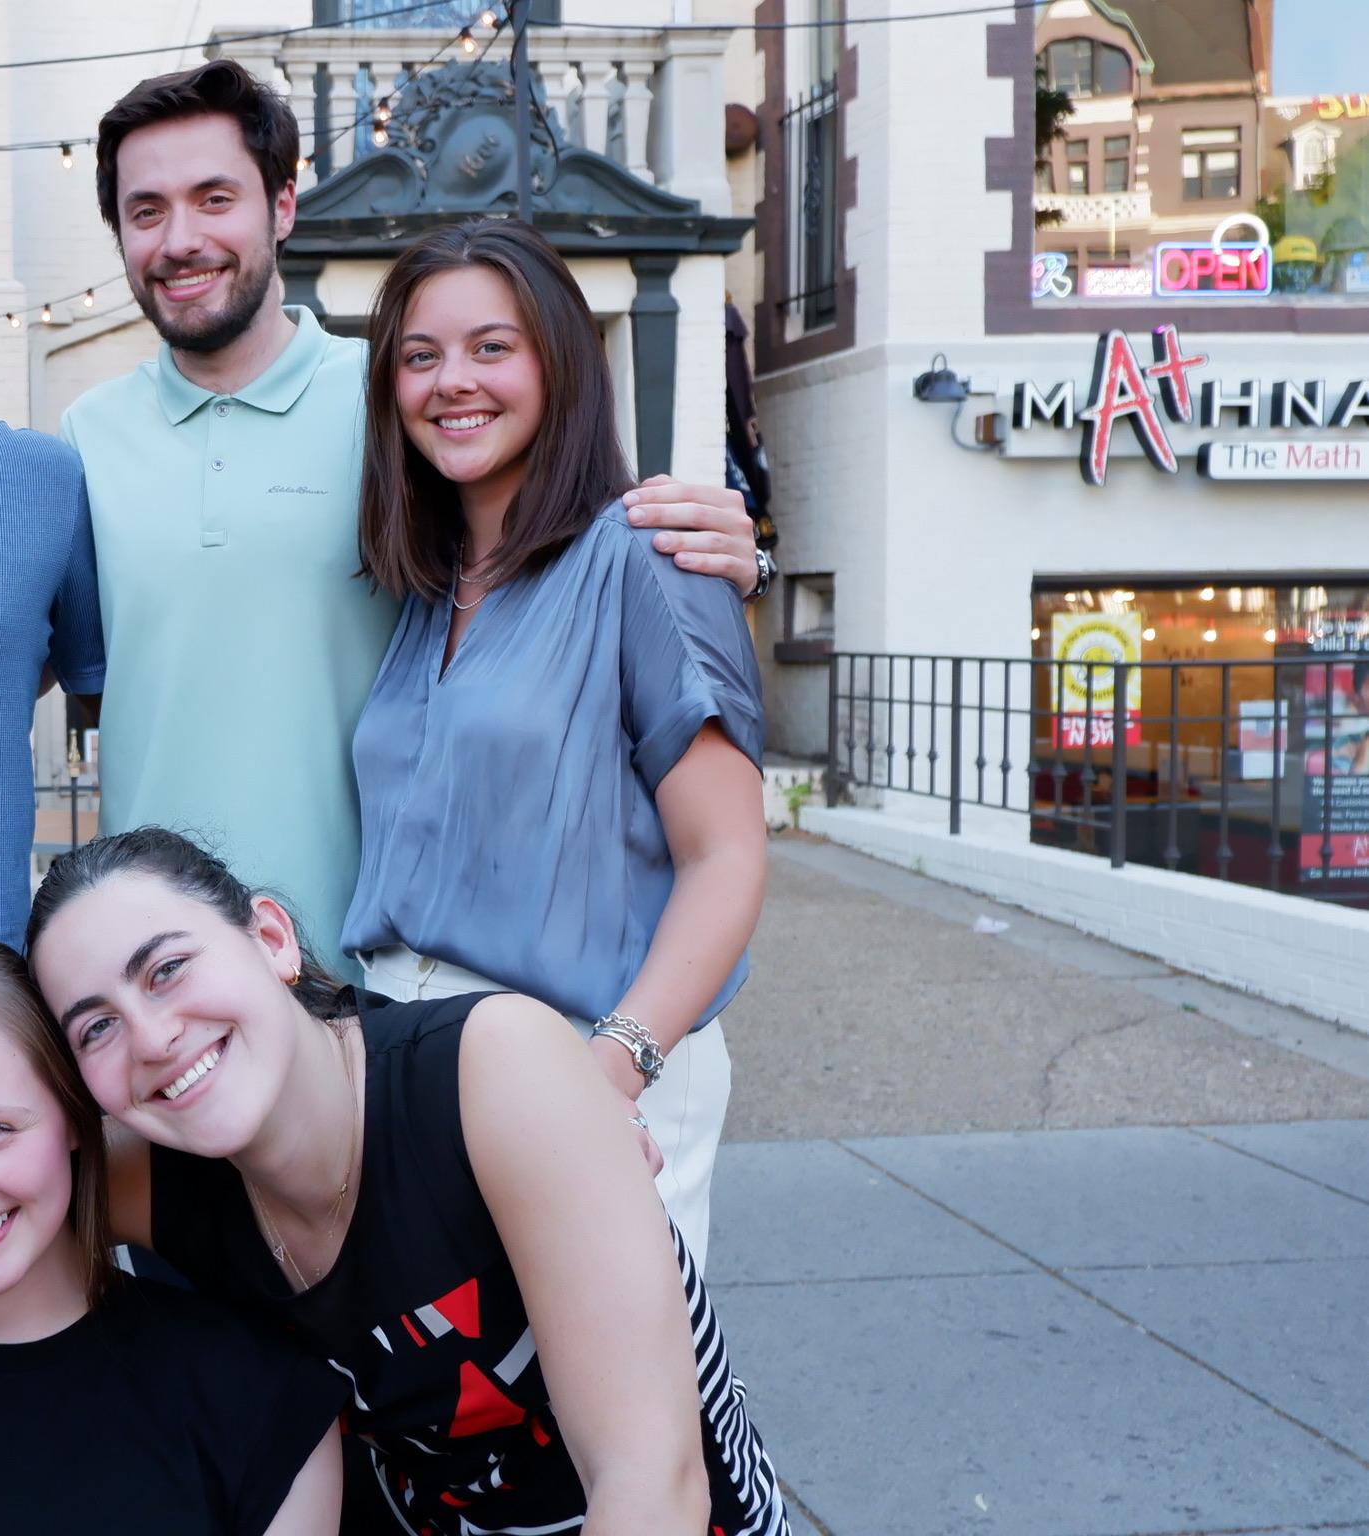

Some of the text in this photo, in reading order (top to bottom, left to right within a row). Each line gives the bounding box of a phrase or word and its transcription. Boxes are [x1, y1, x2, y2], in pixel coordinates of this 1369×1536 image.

[1161, 249, 1266, 290] OPEN
[1223, 443, 1361, 469] The Math
